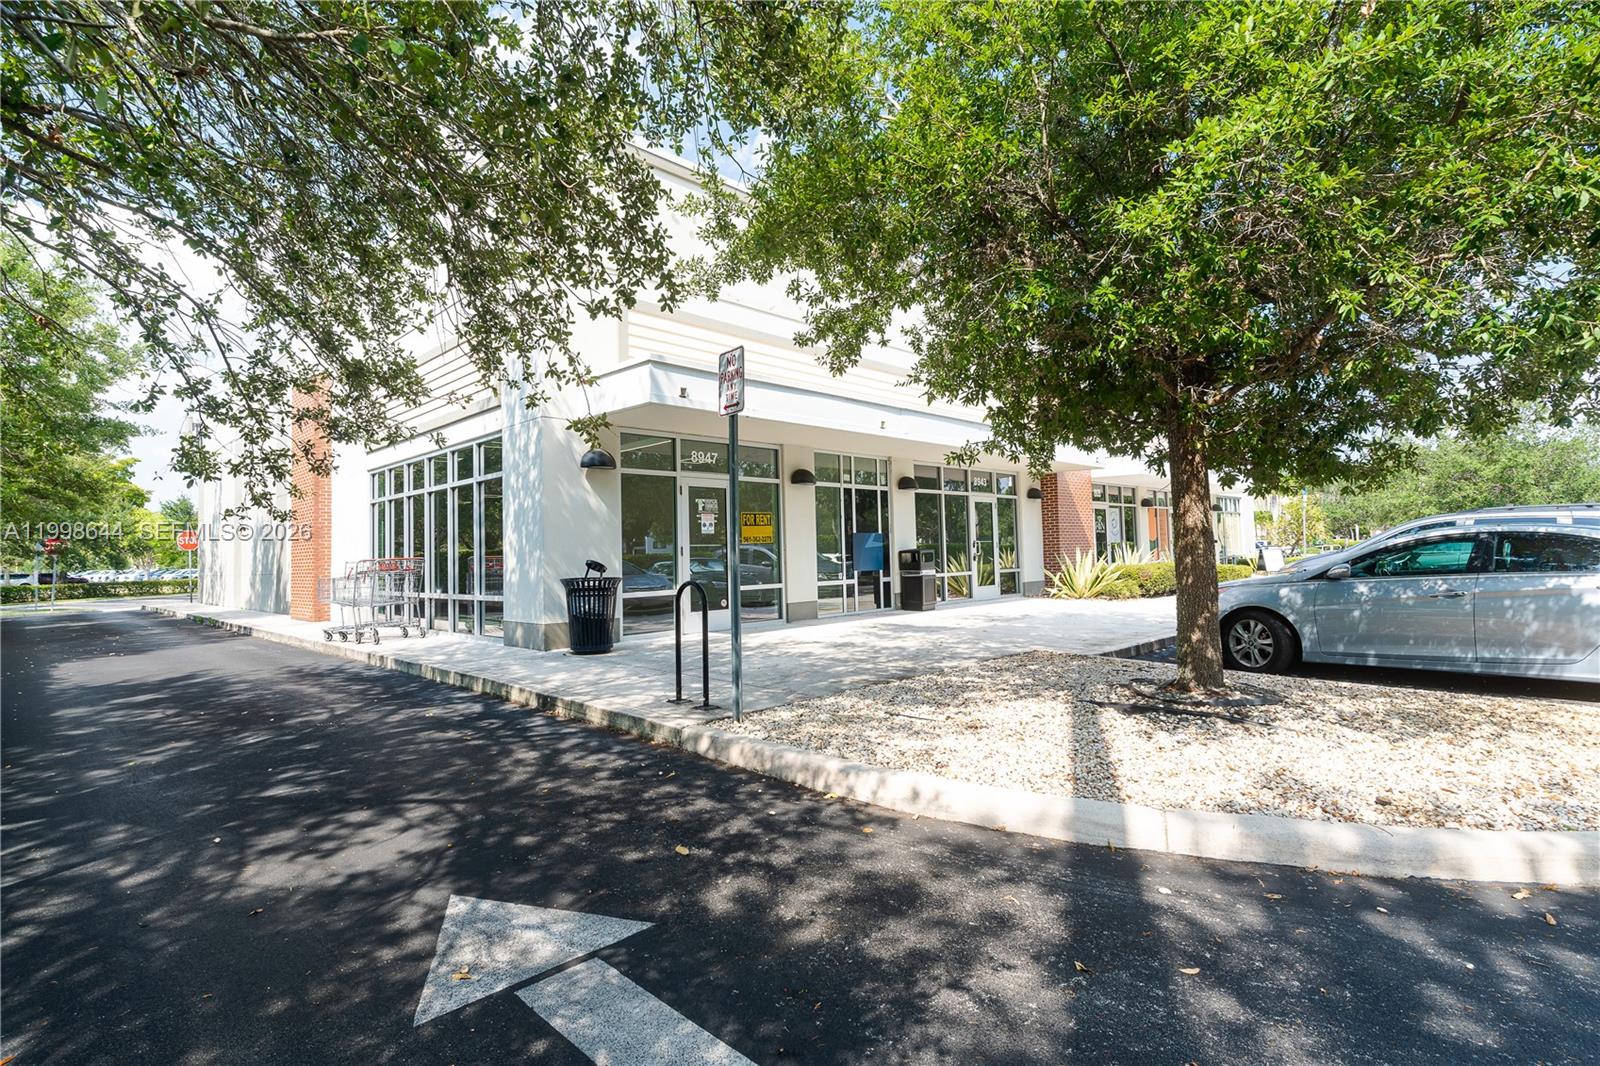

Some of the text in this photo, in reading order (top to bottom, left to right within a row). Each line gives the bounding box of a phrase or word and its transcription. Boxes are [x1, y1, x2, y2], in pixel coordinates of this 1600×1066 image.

[727, 353, 737, 369] NO
[720, 367, 742, 384] PARKING
[691, 450, 718, 464] 8947
[743, 514, 771, 526] FOR RENT
